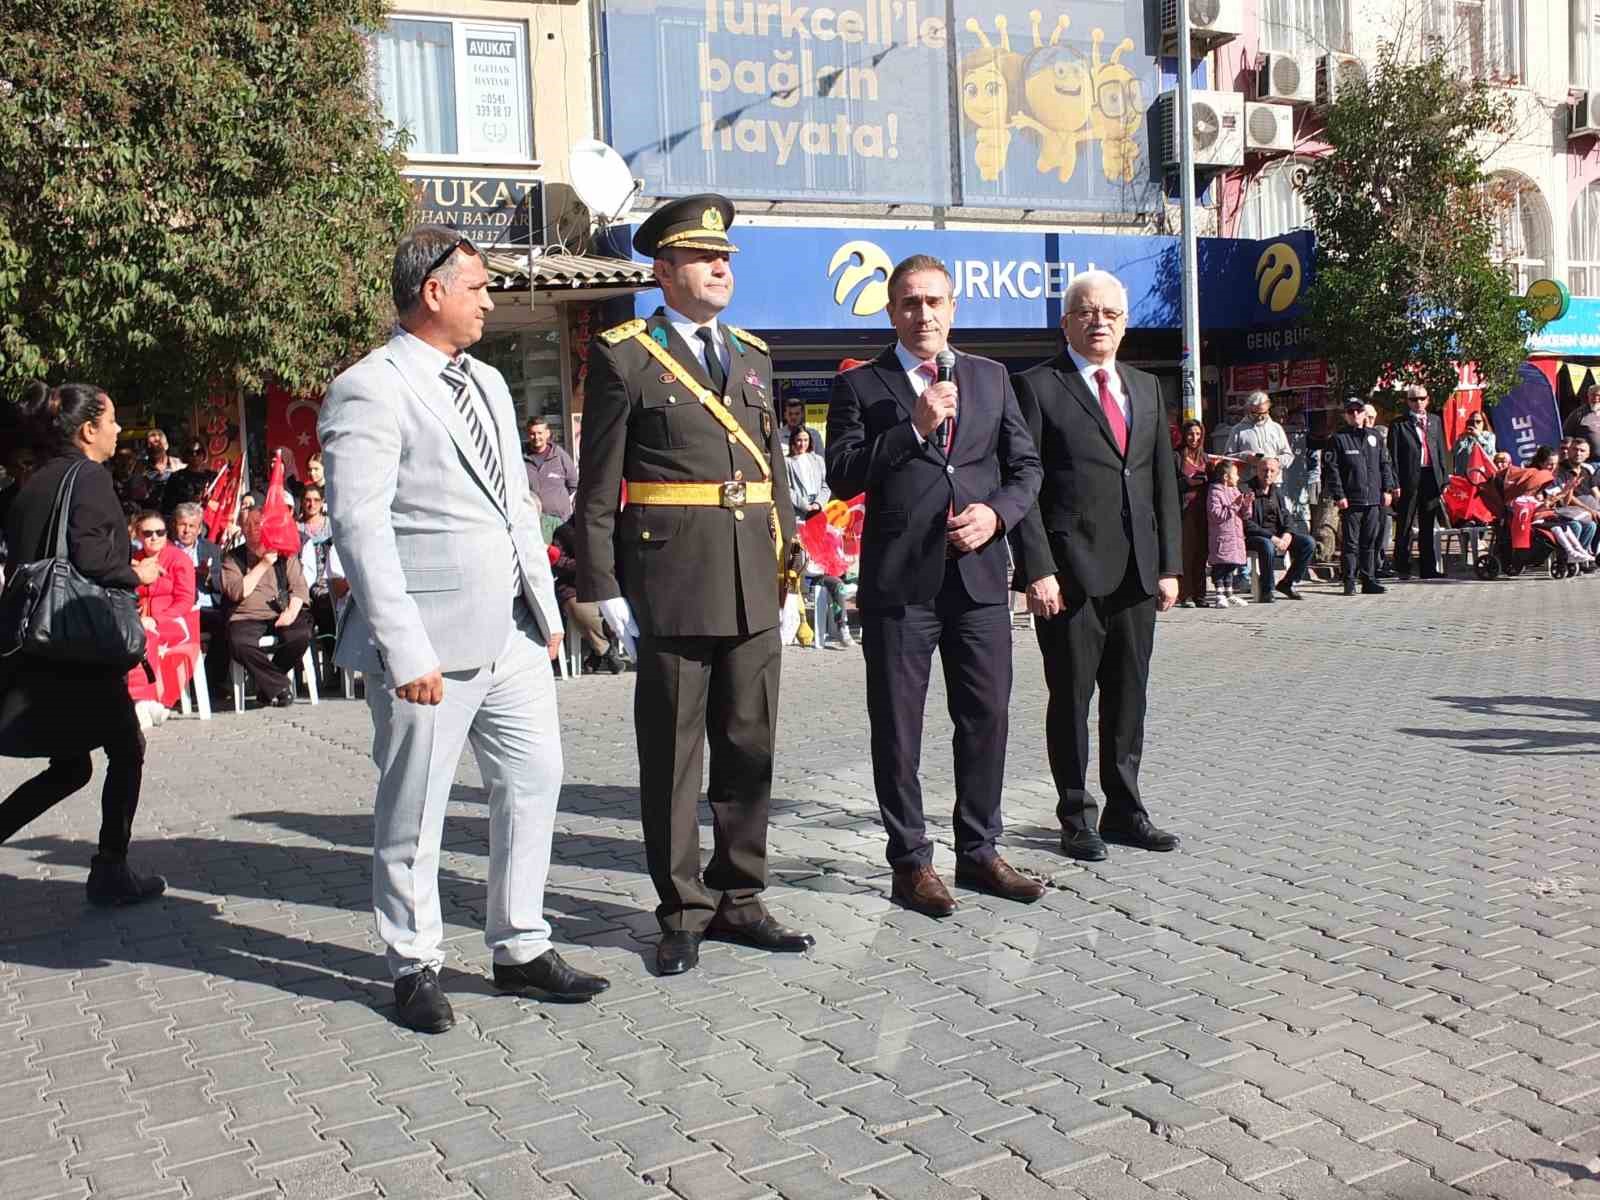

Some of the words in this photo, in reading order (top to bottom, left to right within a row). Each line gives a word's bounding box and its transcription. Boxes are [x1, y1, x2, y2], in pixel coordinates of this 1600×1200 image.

[470, 41, 512, 56] AVUKAT
[698, 42, 878, 108] bağlan
[701, 102, 898, 166] hayata!
[406, 178, 537, 209] VUKAT
[462, 211, 530, 226] BAYDAR
[486, 231, 500, 241] 17
[1247, 330, 1280, 351] GENÇ
